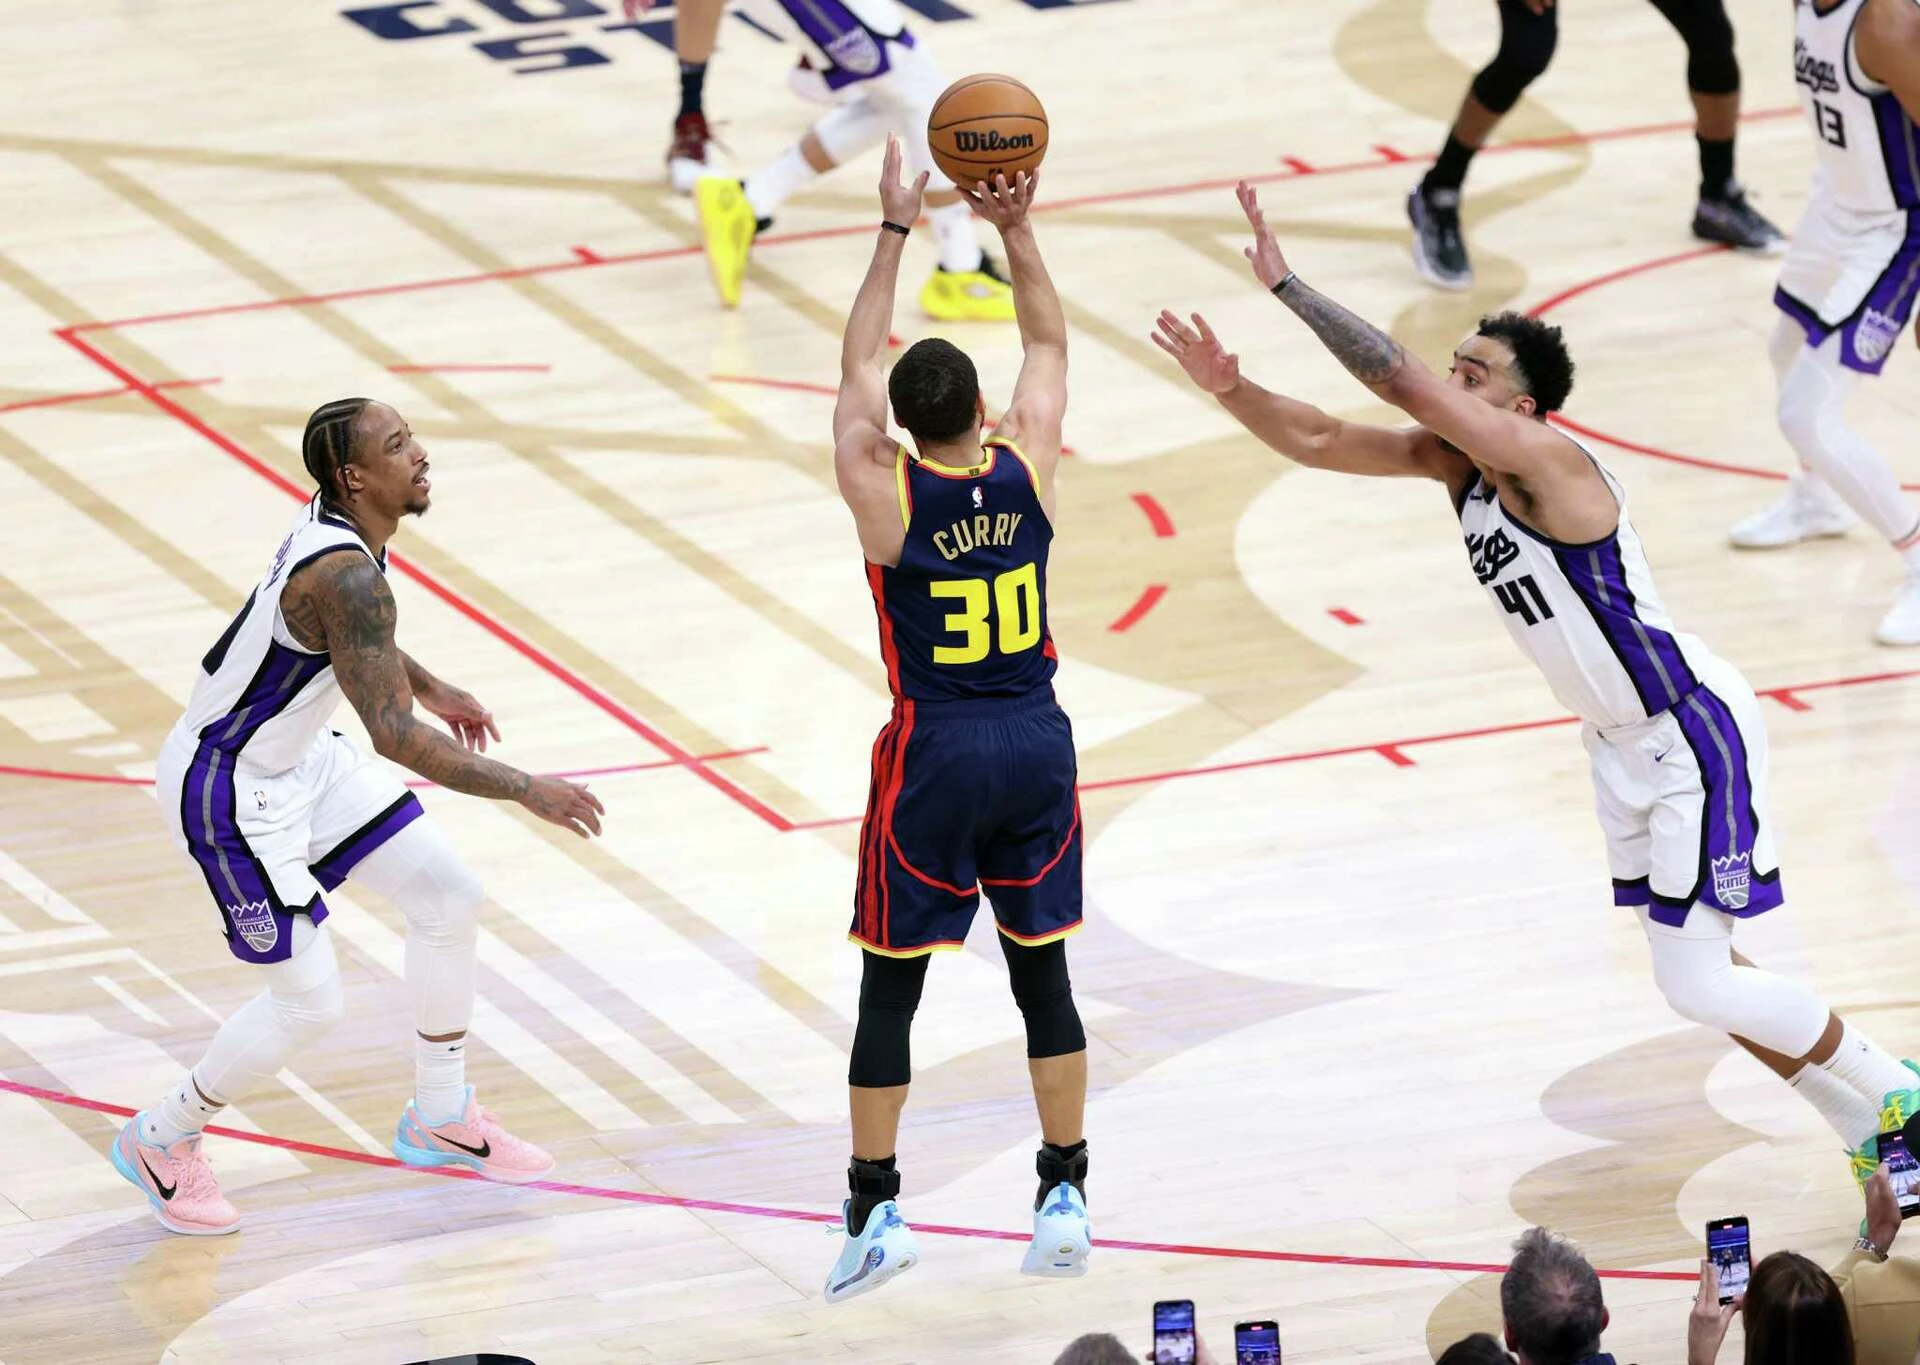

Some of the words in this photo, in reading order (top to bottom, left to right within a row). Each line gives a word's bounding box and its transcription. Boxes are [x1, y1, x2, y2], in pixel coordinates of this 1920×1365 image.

[954, 130, 1034, 152] Wilson
[1812, 98, 1847, 148] 13
[932, 513, 1023, 561] CURRY
[930, 561, 1041, 665] 30
[1492, 574, 1555, 626] 41
